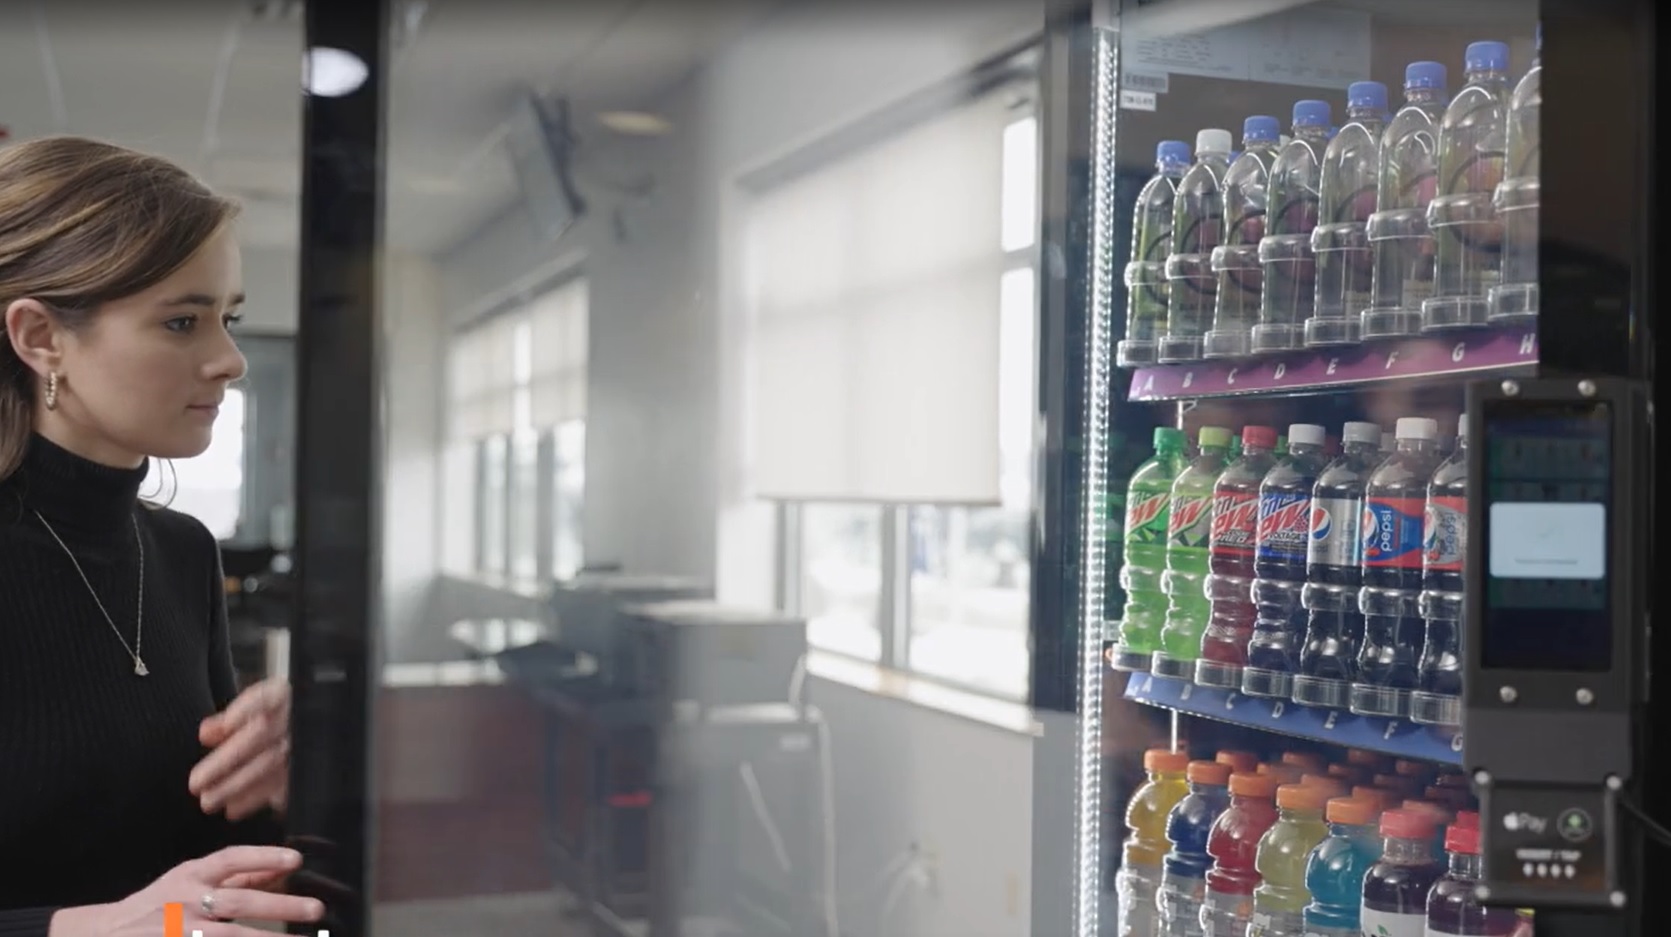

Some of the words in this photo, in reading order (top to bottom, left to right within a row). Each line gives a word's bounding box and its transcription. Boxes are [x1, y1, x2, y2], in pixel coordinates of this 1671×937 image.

[1143, 375, 1154, 391] A
[1182, 372, 1193, 388] B
[1227, 368, 1238, 384] C
[1273, 363, 1286, 379] D
[1326, 358, 1340, 375] E
[1385, 351, 1399, 369] F
[1451, 342, 1466, 362] G
[1518, 333, 1535, 354] H
[1380, 510, 1394, 552] pepsi
[1445, 512, 1457, 556] pepsi
[1141, 676, 1153, 693] A
[1180, 683, 1192, 700] B
[1225, 692, 1235, 710] C
[1271, 701, 1284, 719] D
[1323, 711, 1337, 729] E
[1383, 721, 1398, 740] F
[1518, 812, 1548, 835] Pay
